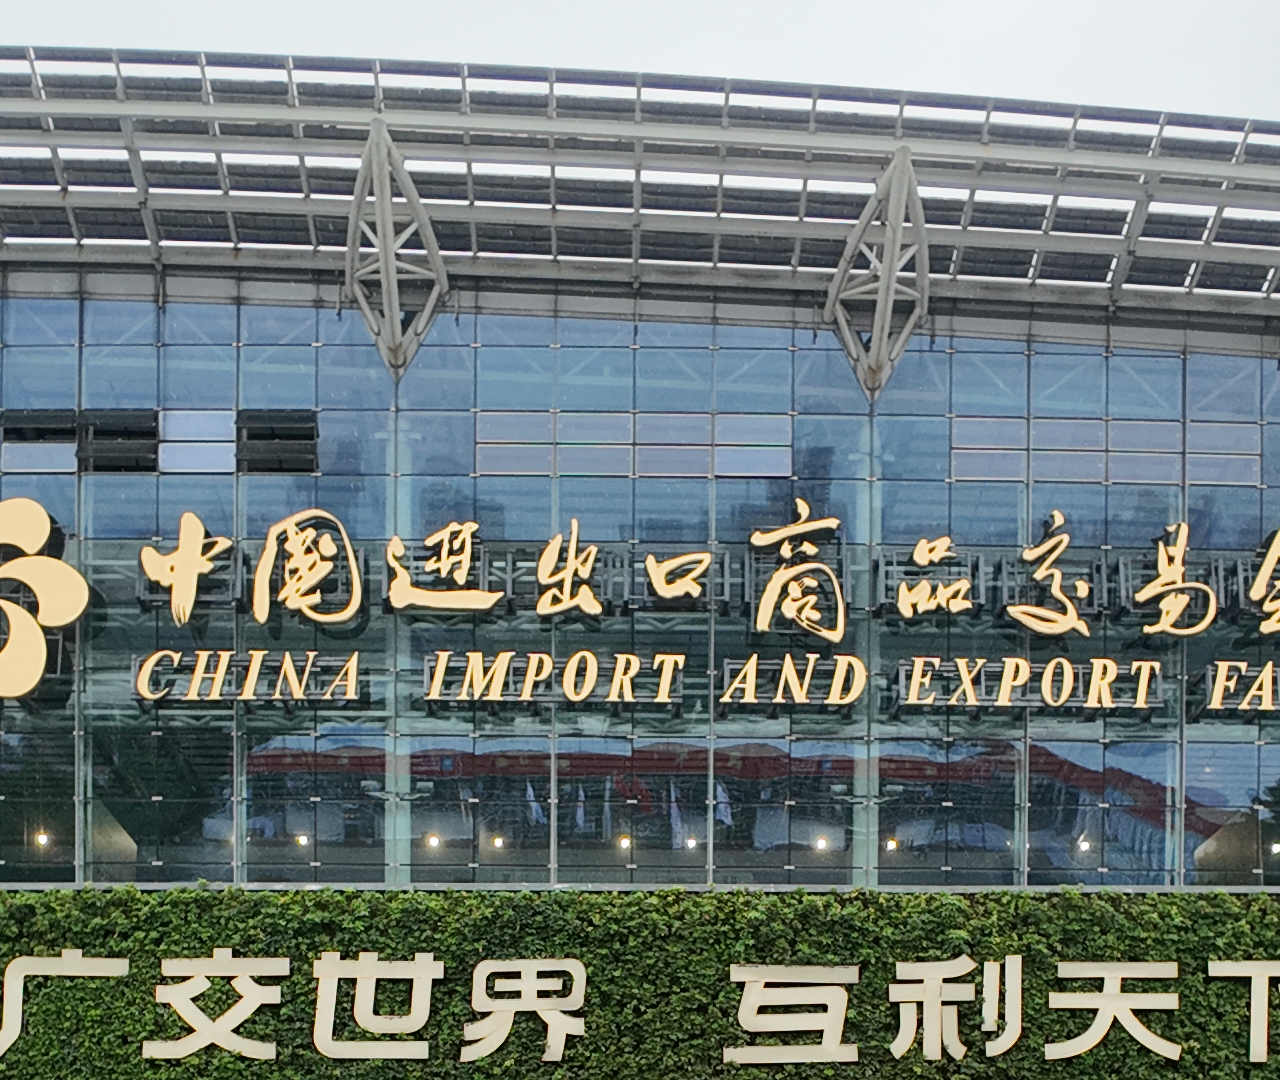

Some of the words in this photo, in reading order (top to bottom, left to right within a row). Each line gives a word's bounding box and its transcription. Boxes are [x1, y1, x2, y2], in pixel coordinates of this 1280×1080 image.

[135, 649, 359, 701] CHINA
[426, 649, 687, 704] IMPORT
[720, 652, 869, 706] AND
[905, 656, 1162, 709] EXPORT
